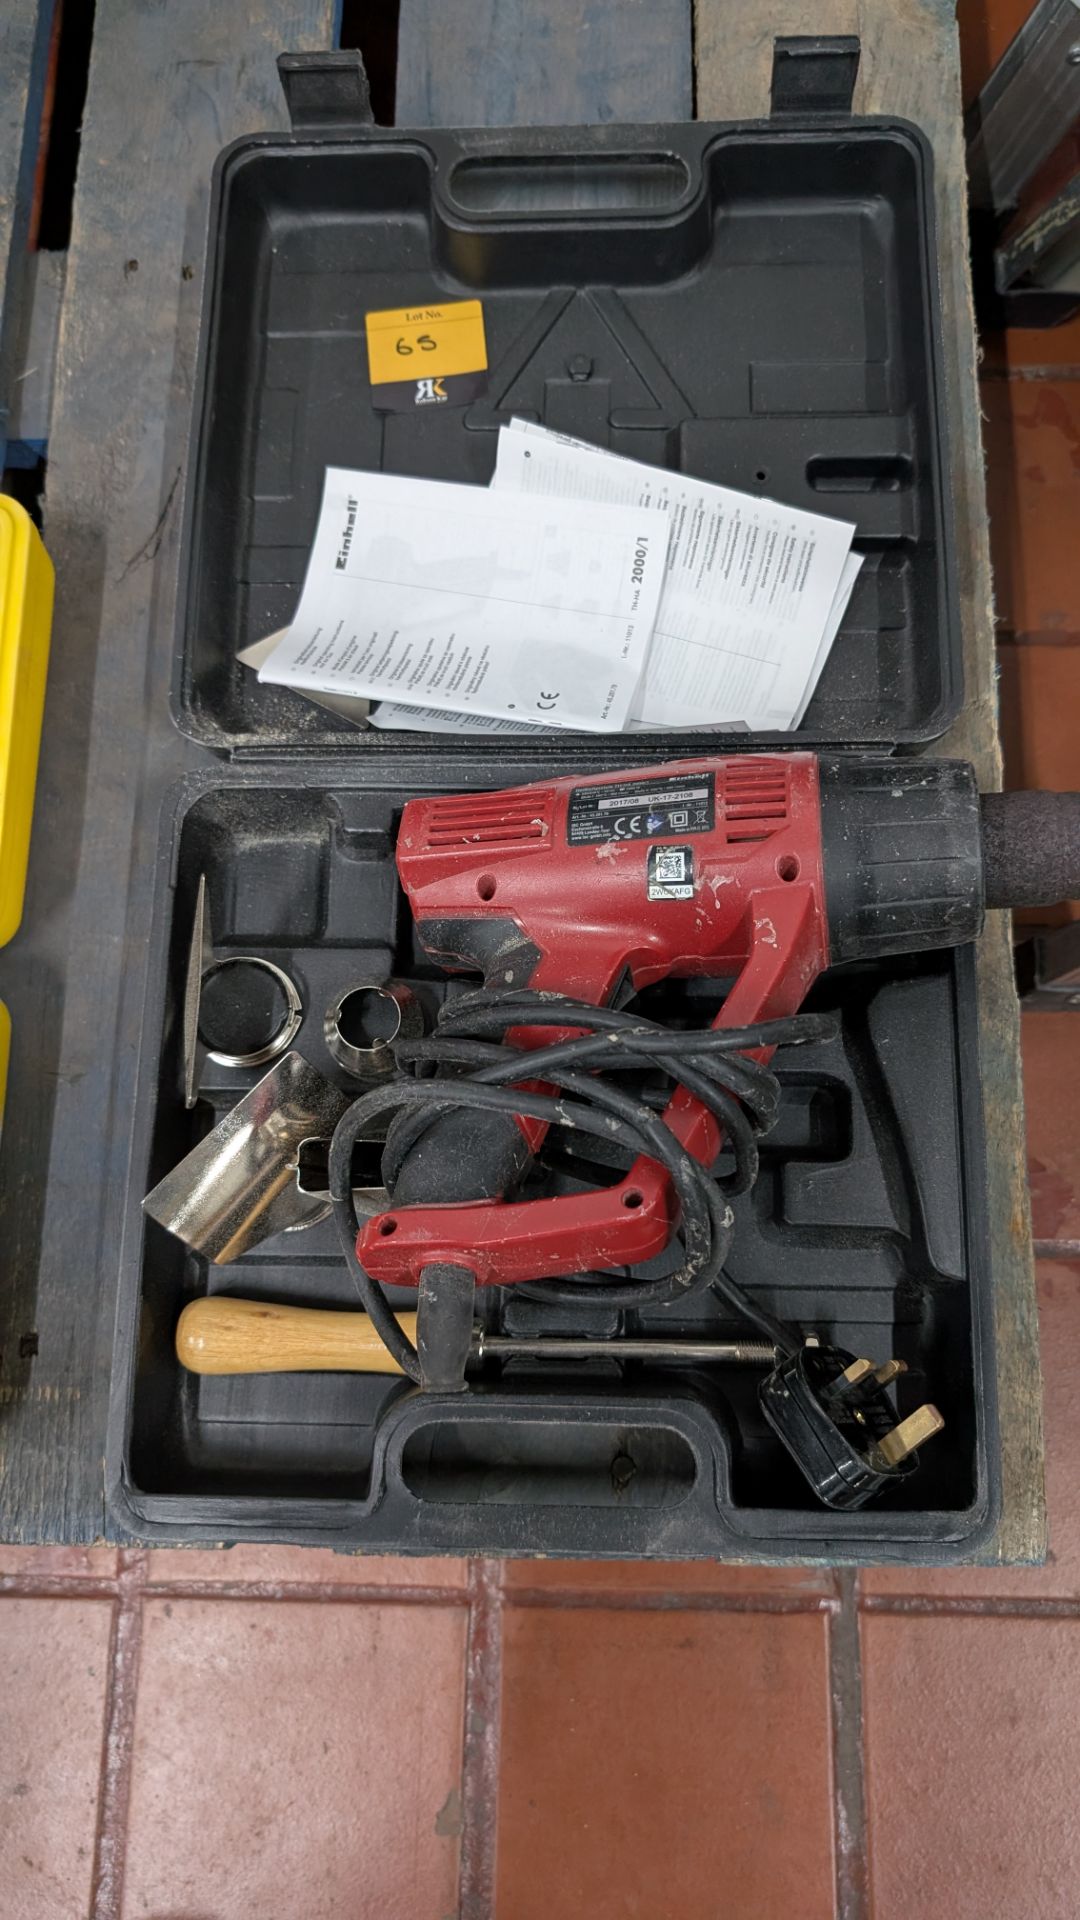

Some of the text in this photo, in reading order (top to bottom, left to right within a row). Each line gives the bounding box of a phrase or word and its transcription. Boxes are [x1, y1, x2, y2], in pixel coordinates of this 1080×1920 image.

[405, 310, 443, 322] Lot No.
[631, 536, 649, 584] 2000/1
[648, 792, 694, 803] UK-17-2108
